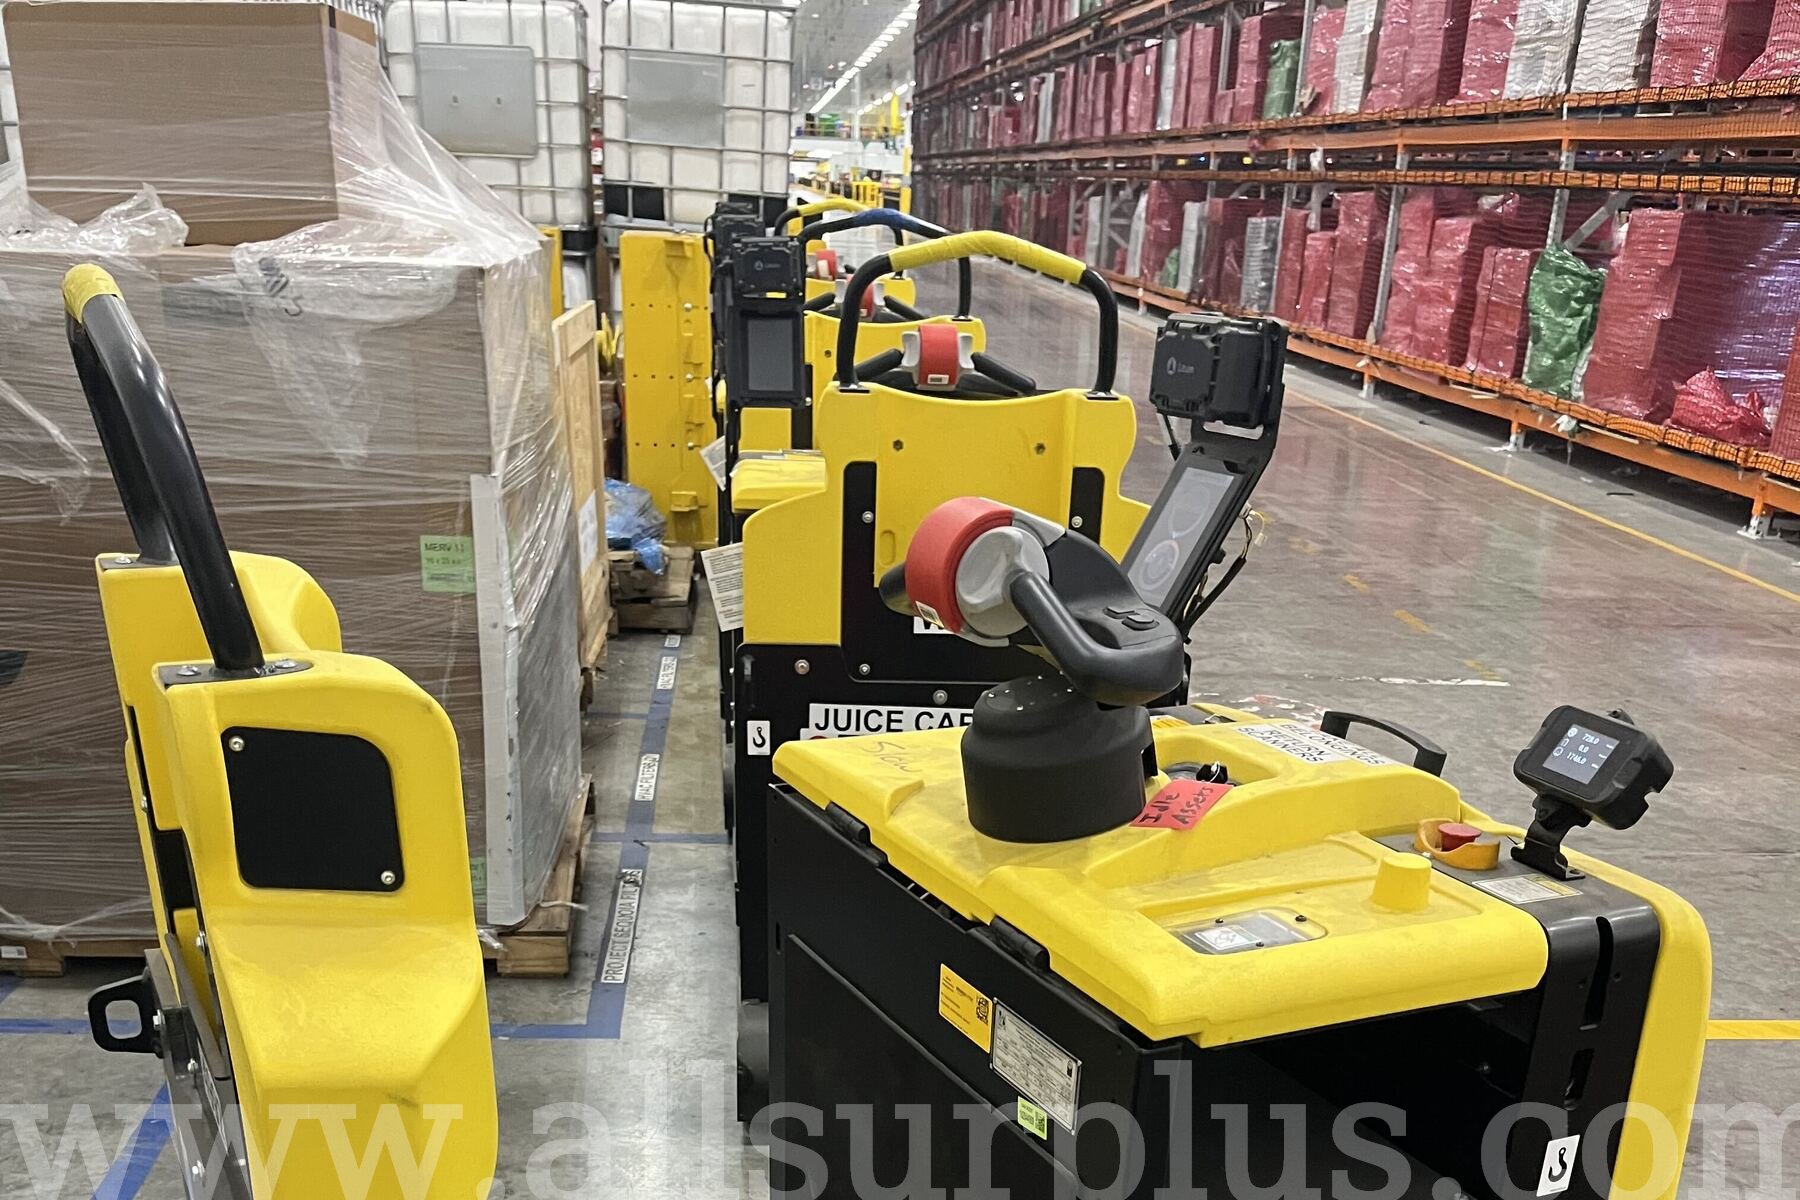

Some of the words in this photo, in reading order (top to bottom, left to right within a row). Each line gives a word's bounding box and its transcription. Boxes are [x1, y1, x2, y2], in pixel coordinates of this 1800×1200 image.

[814, 708, 904, 733] JUICE
[1238, 727, 1324, 762] SCANNERS
[1261, 728, 1332, 756] RETURN
[1280, 724, 1385, 765] BELONGINGS
[1138, 792, 1180, 824] Idle
[612, 901, 636, 938] SEQUOIA
[603, 940, 630, 981] PROJECT
